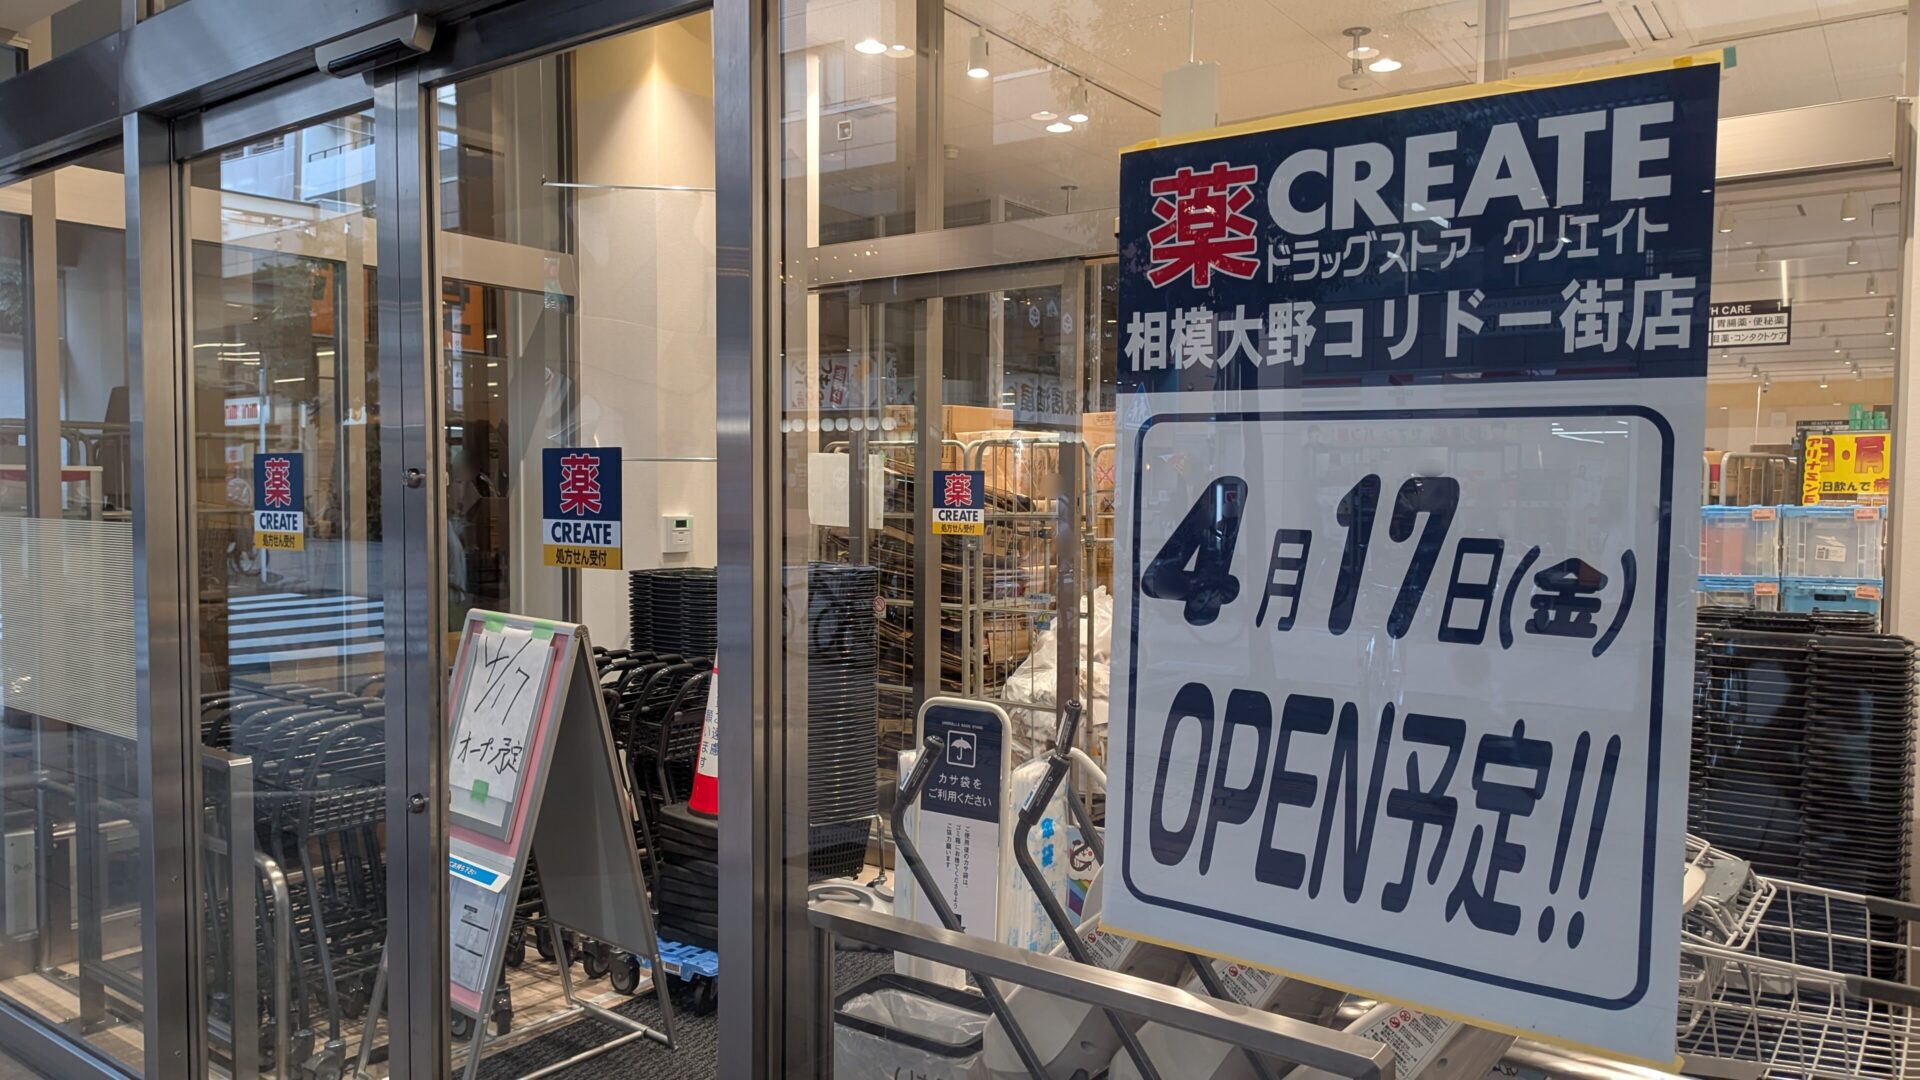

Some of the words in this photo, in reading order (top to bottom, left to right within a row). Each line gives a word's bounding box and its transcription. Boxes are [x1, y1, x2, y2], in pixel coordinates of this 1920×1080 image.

[1267, 101, 1674, 236] CREATE
[1147, 161, 1260, 289] 薬
[1266, 228, 1471, 284] ドラッグストア
[1504, 207, 1669, 264] クリエイト
[1710, 306, 1719, 316] H
[1721, 304, 1752, 315] CARE
[1717, 315, 1785, 328] 胃腸薬・便秘薬
[1125, 273, 1697, 372] 相模大野コリドー街店
[1713, 331, 1787, 343] 目薬・コンタクトケア
[264, 457, 291, 508] 薬
[1804, 438, 1820, 503] アリナミンE
[560, 453, 602, 516] 薬
[944, 473, 972, 507] 薬
[1819, 477, 1889, 493] 日飲んで
[259, 512, 298, 531] CREATE
[938, 509, 979, 522] CREATE
[262, 534, 295, 548] 処方せん受付
[551, 521, 612, 545] CREATE
[941, 524, 975, 534] 処方せん受付
[555, 547, 607, 567] 処方せん受付
[1141, 472, 1638, 658] 4月17日(金)
[474, 636, 533, 726] 4/17
[938, 772, 983, 790] カサ袋を
[928, 788, 992, 807] ご利用ください
[1148, 681, 1622, 950] OPEN予定!!
